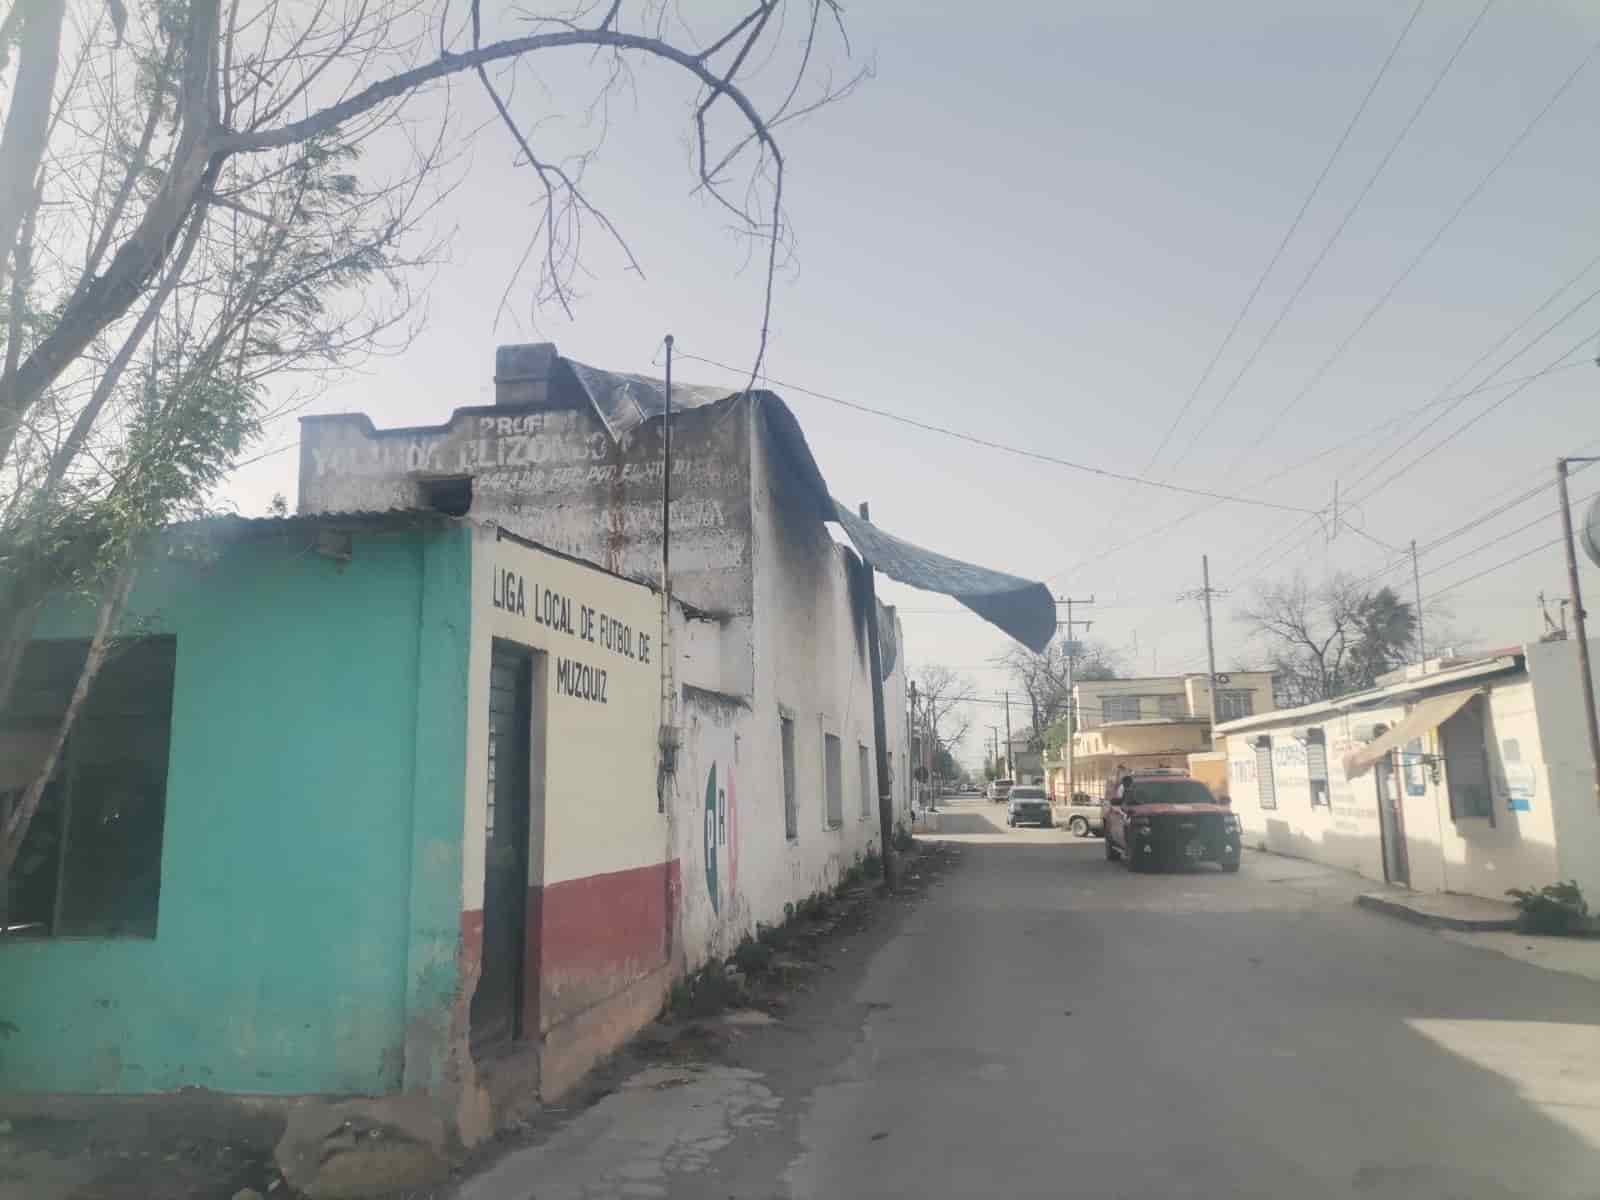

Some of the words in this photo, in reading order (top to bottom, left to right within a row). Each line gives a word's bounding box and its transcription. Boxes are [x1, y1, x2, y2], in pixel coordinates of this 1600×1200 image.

[492, 566, 526, 617] LIGA
[534, 583, 575, 636] LOCAL
[580, 605, 595, 643] DE
[599, 613, 635, 659] FUTBOL
[638, 631, 651, 664] DE
[556, 656, 608, 704] MUZQUIZ
